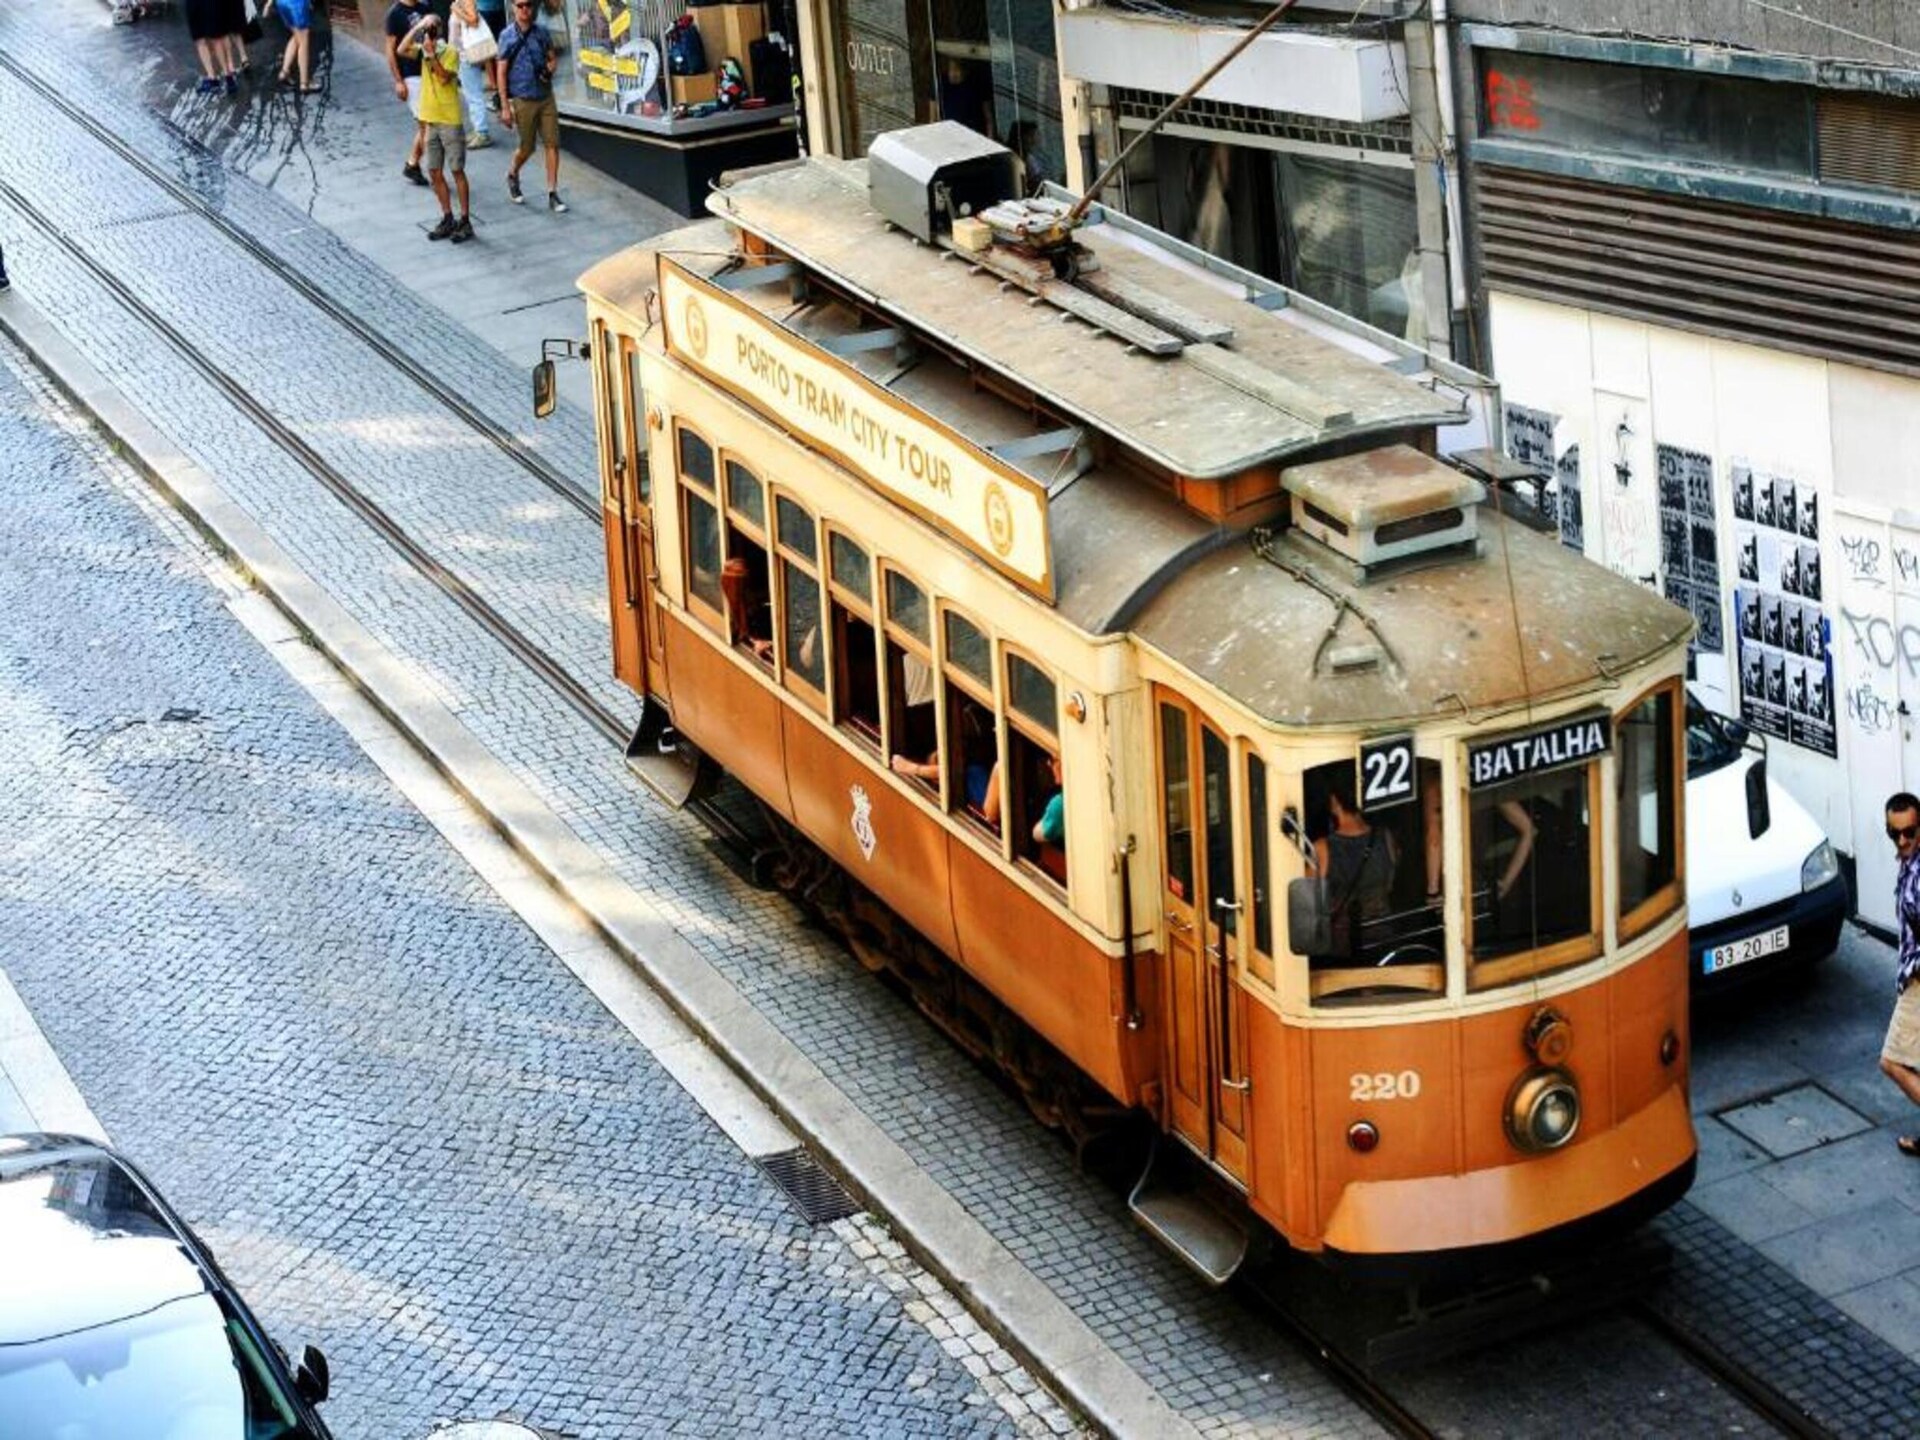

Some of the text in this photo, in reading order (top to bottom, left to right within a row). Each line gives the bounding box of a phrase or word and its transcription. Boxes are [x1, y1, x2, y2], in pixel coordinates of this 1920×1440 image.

[846, 41, 895, 75] OUTLET
[737, 333, 953, 499] PORTO TRAM CITY TOUR
[1365, 747, 1411, 800] 22
[1474, 722, 1606, 783] BATALHA
[1350, 1070, 1421, 1101] 220
